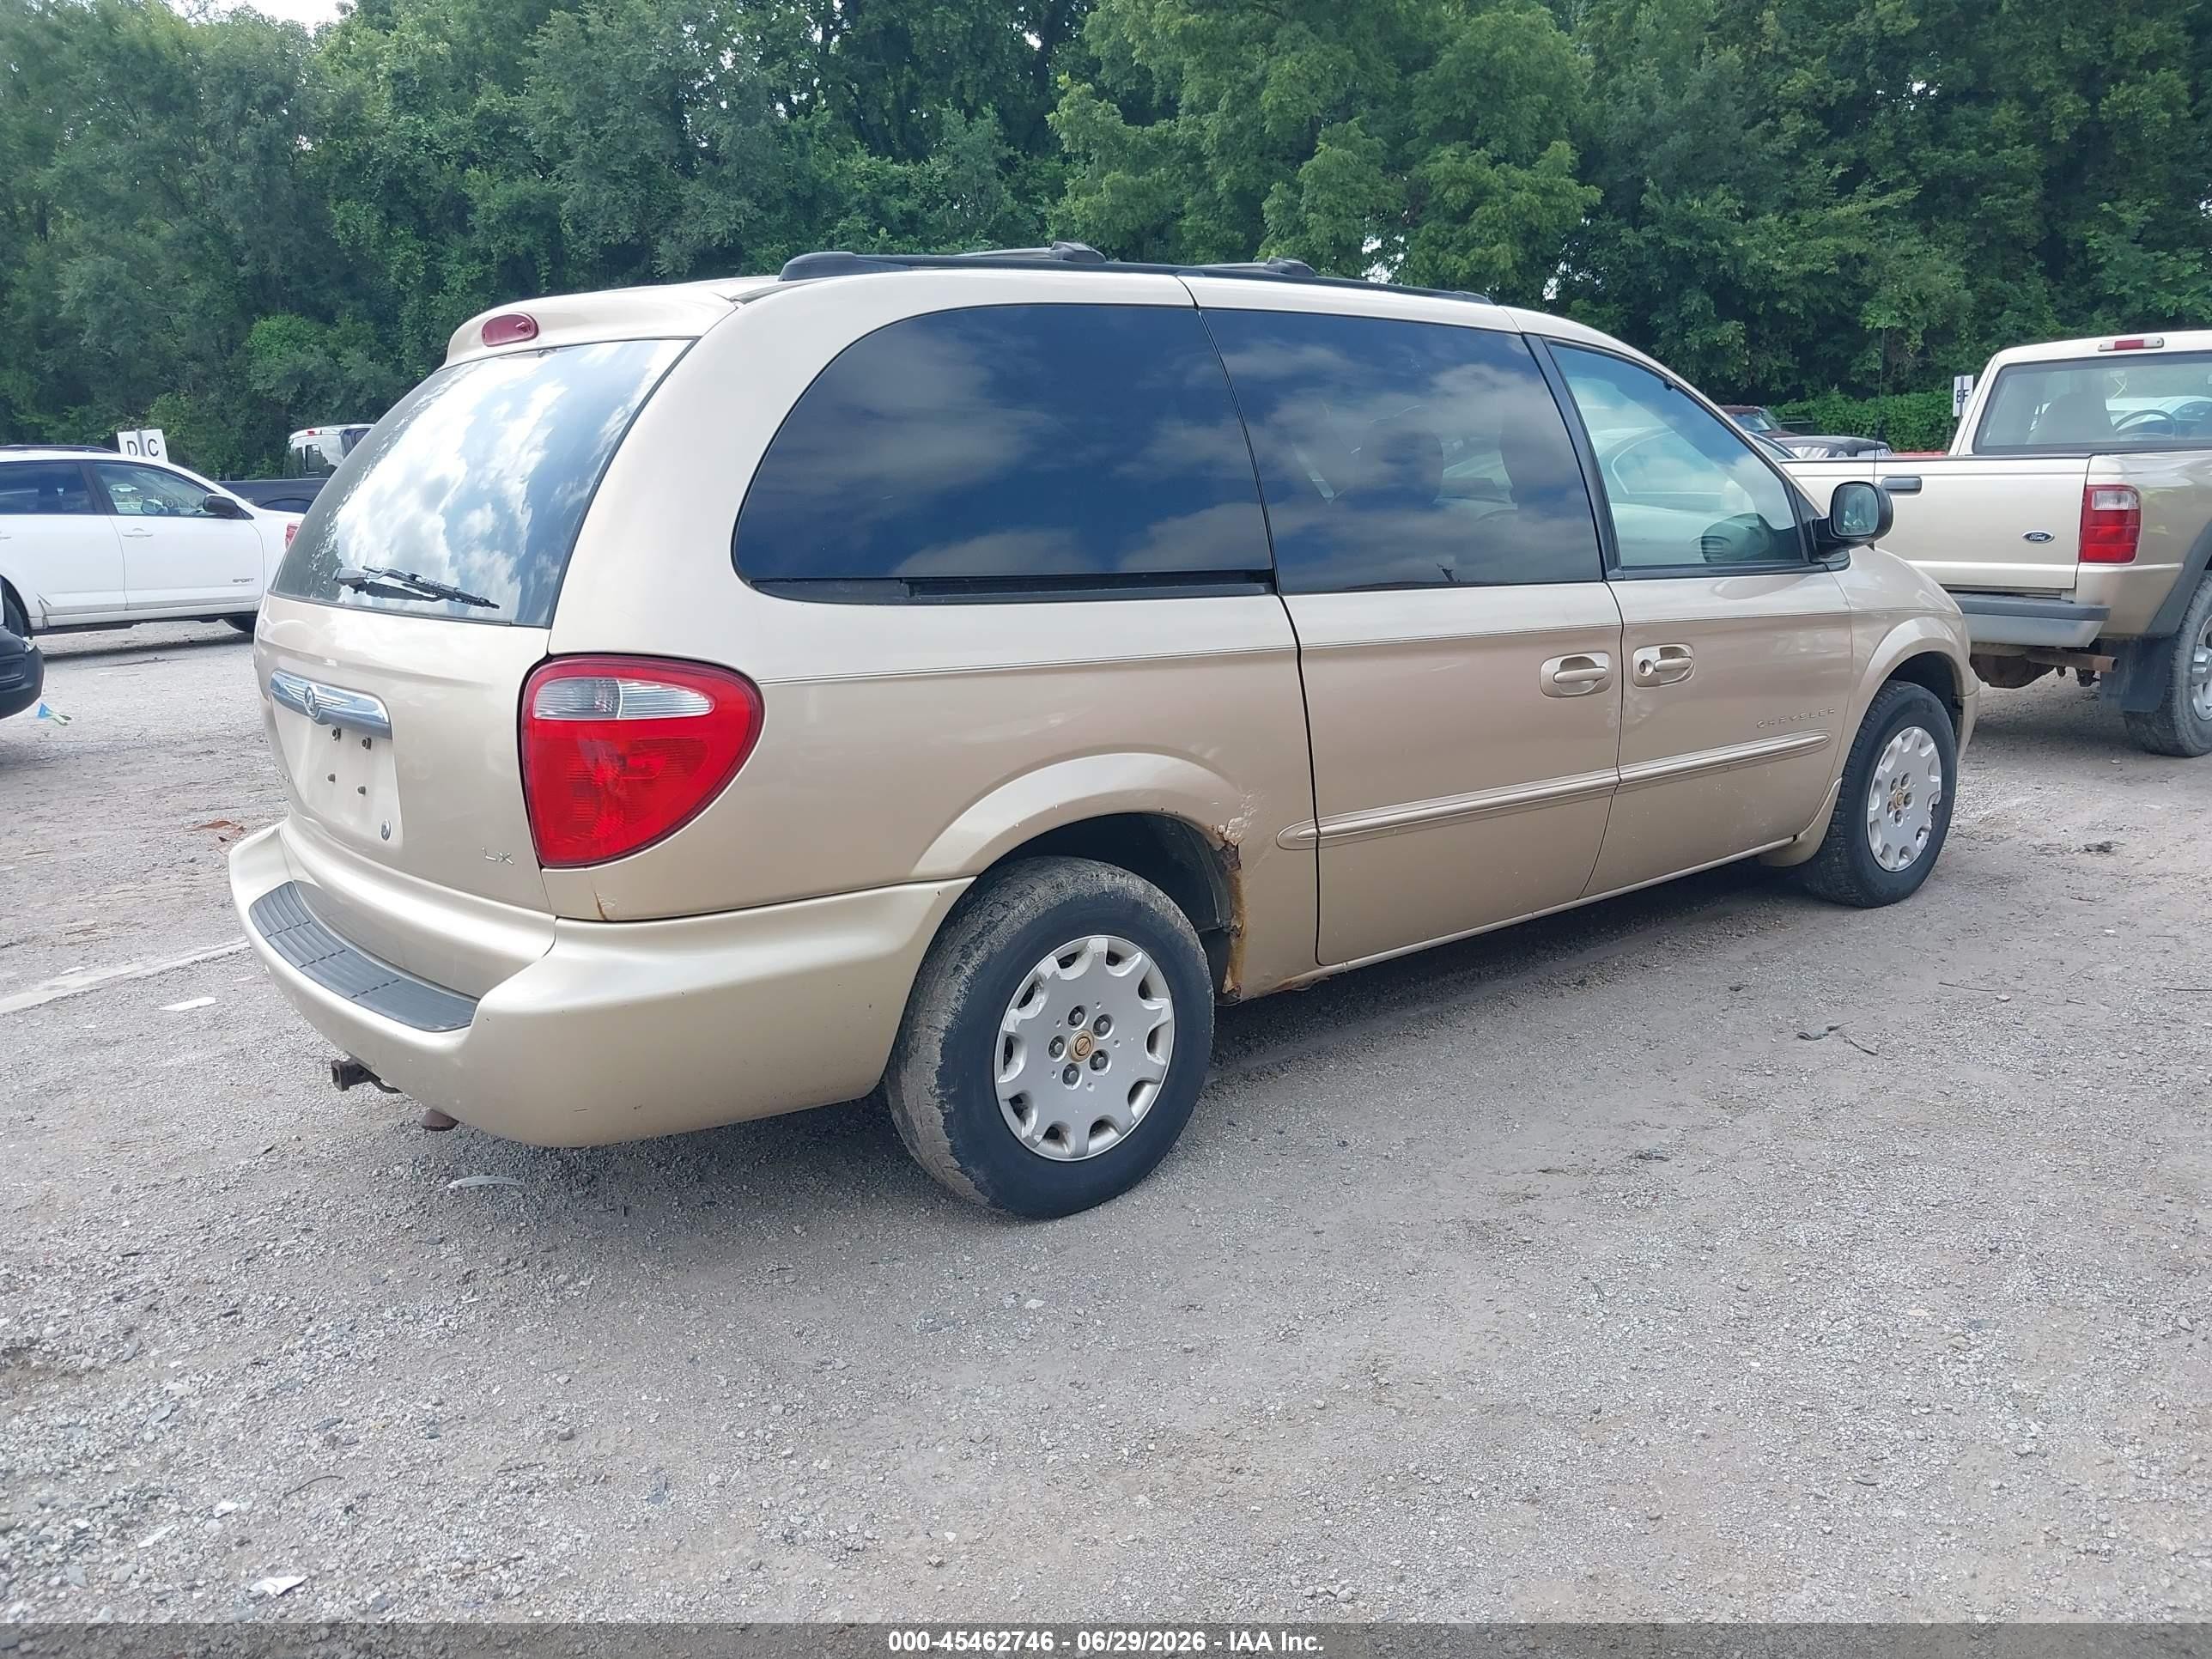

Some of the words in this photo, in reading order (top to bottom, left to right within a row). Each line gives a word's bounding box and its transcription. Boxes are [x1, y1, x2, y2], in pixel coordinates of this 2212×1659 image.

[126, 440, 138, 456] D
[147, 438, 159, 457] C
[1756, 707, 1835, 729] CHRYSLER
[481, 845, 515, 866] LX
